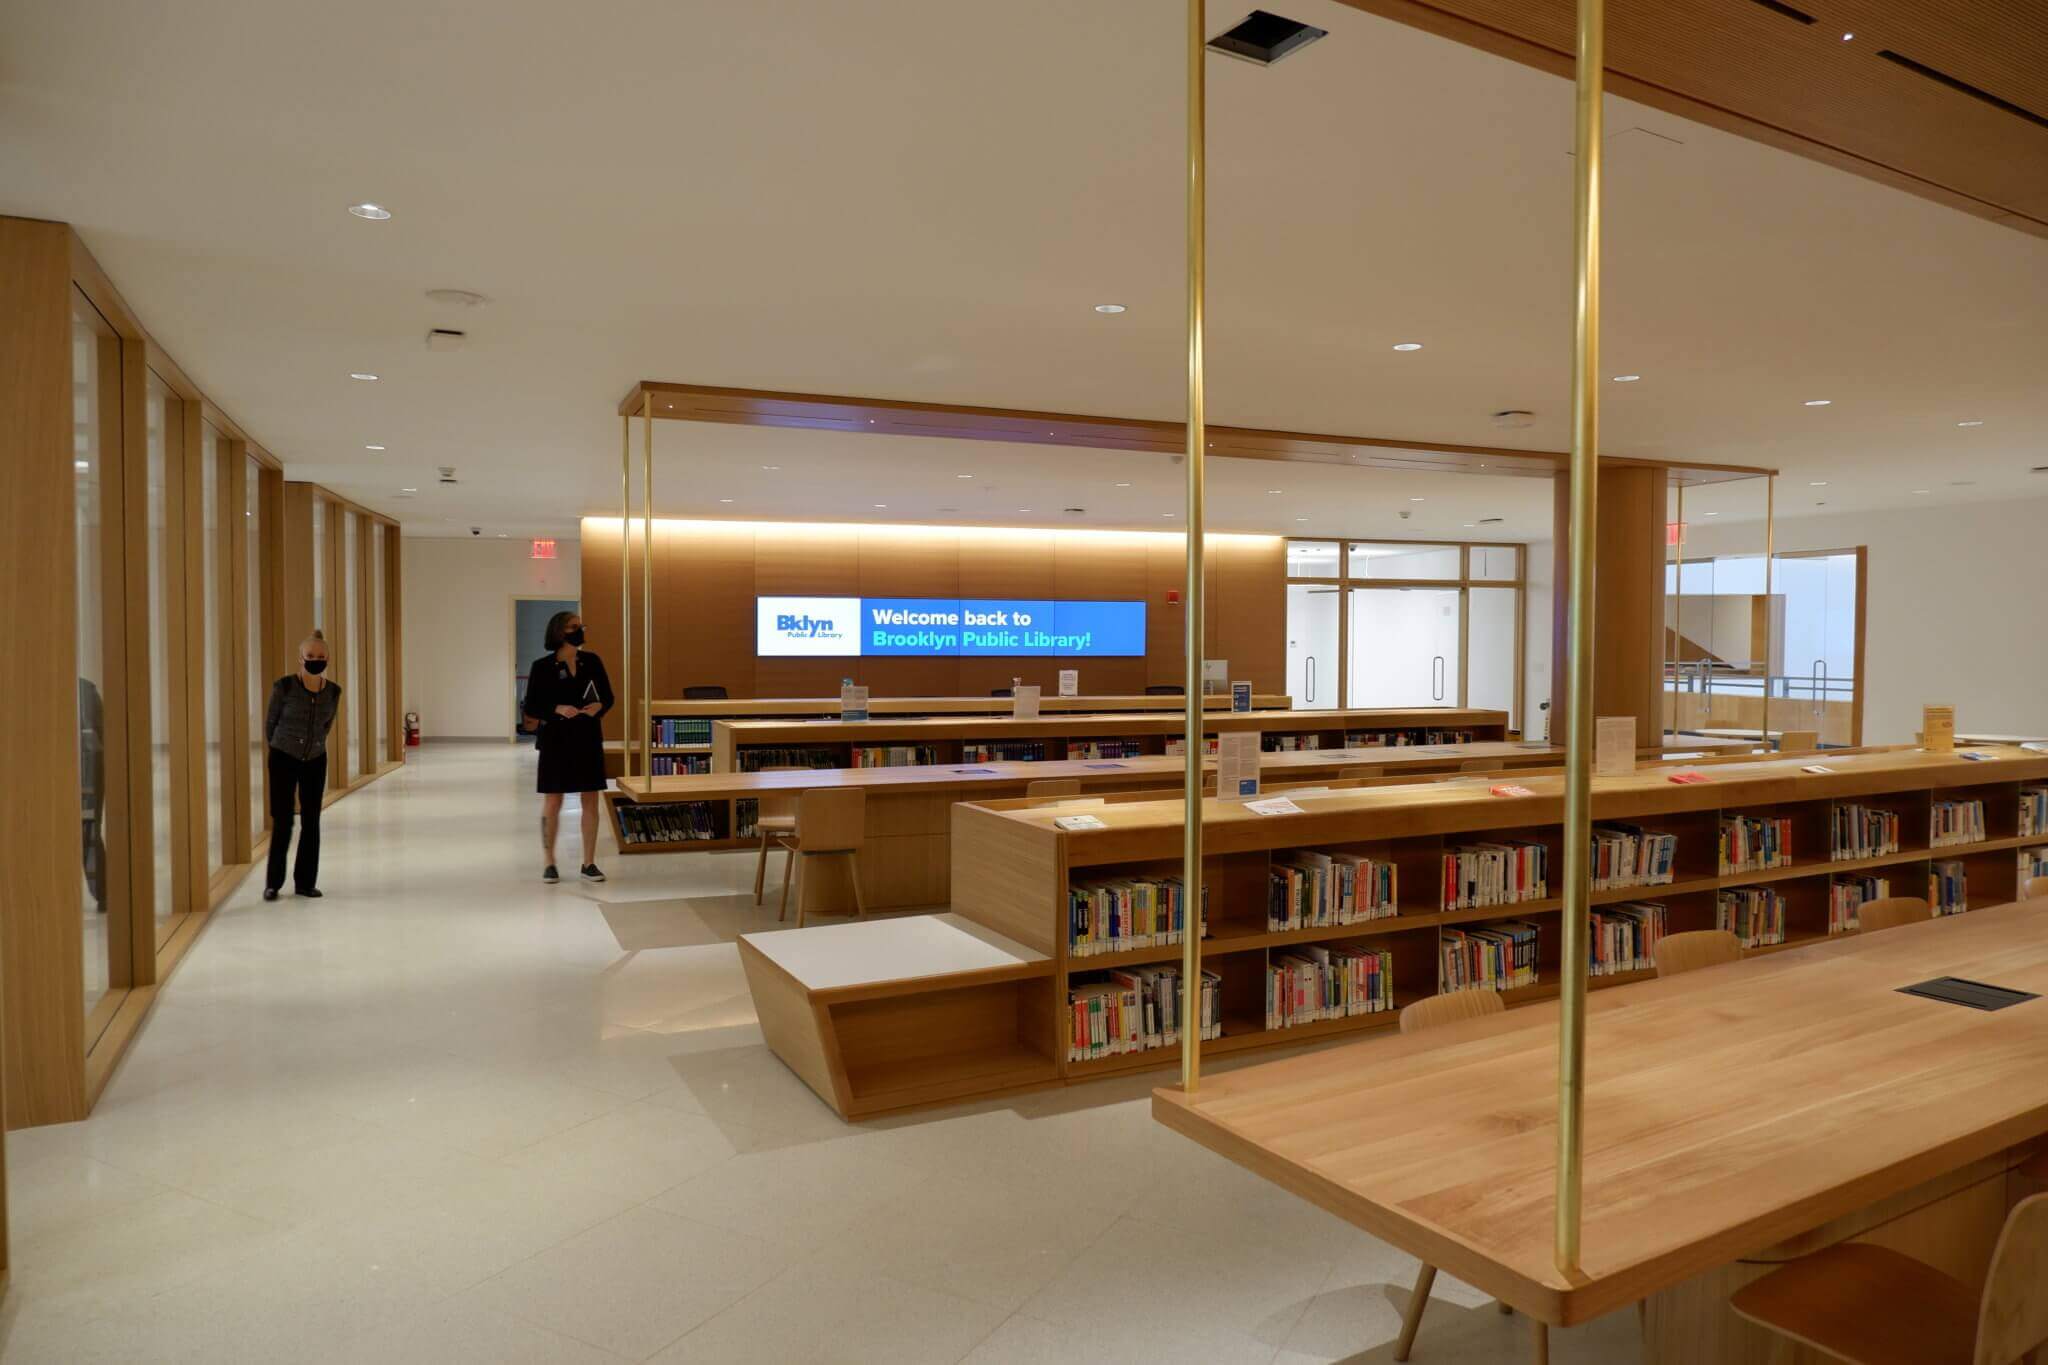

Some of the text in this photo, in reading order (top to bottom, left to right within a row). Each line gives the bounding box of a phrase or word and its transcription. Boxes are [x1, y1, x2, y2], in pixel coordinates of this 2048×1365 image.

[777, 614, 834, 638] Bklyn
[872, 608, 1032, 627] Welcome back to
[787, 631, 843, 640] Public Library
[873, 629, 1092, 651] Brooklyn Public Library!
